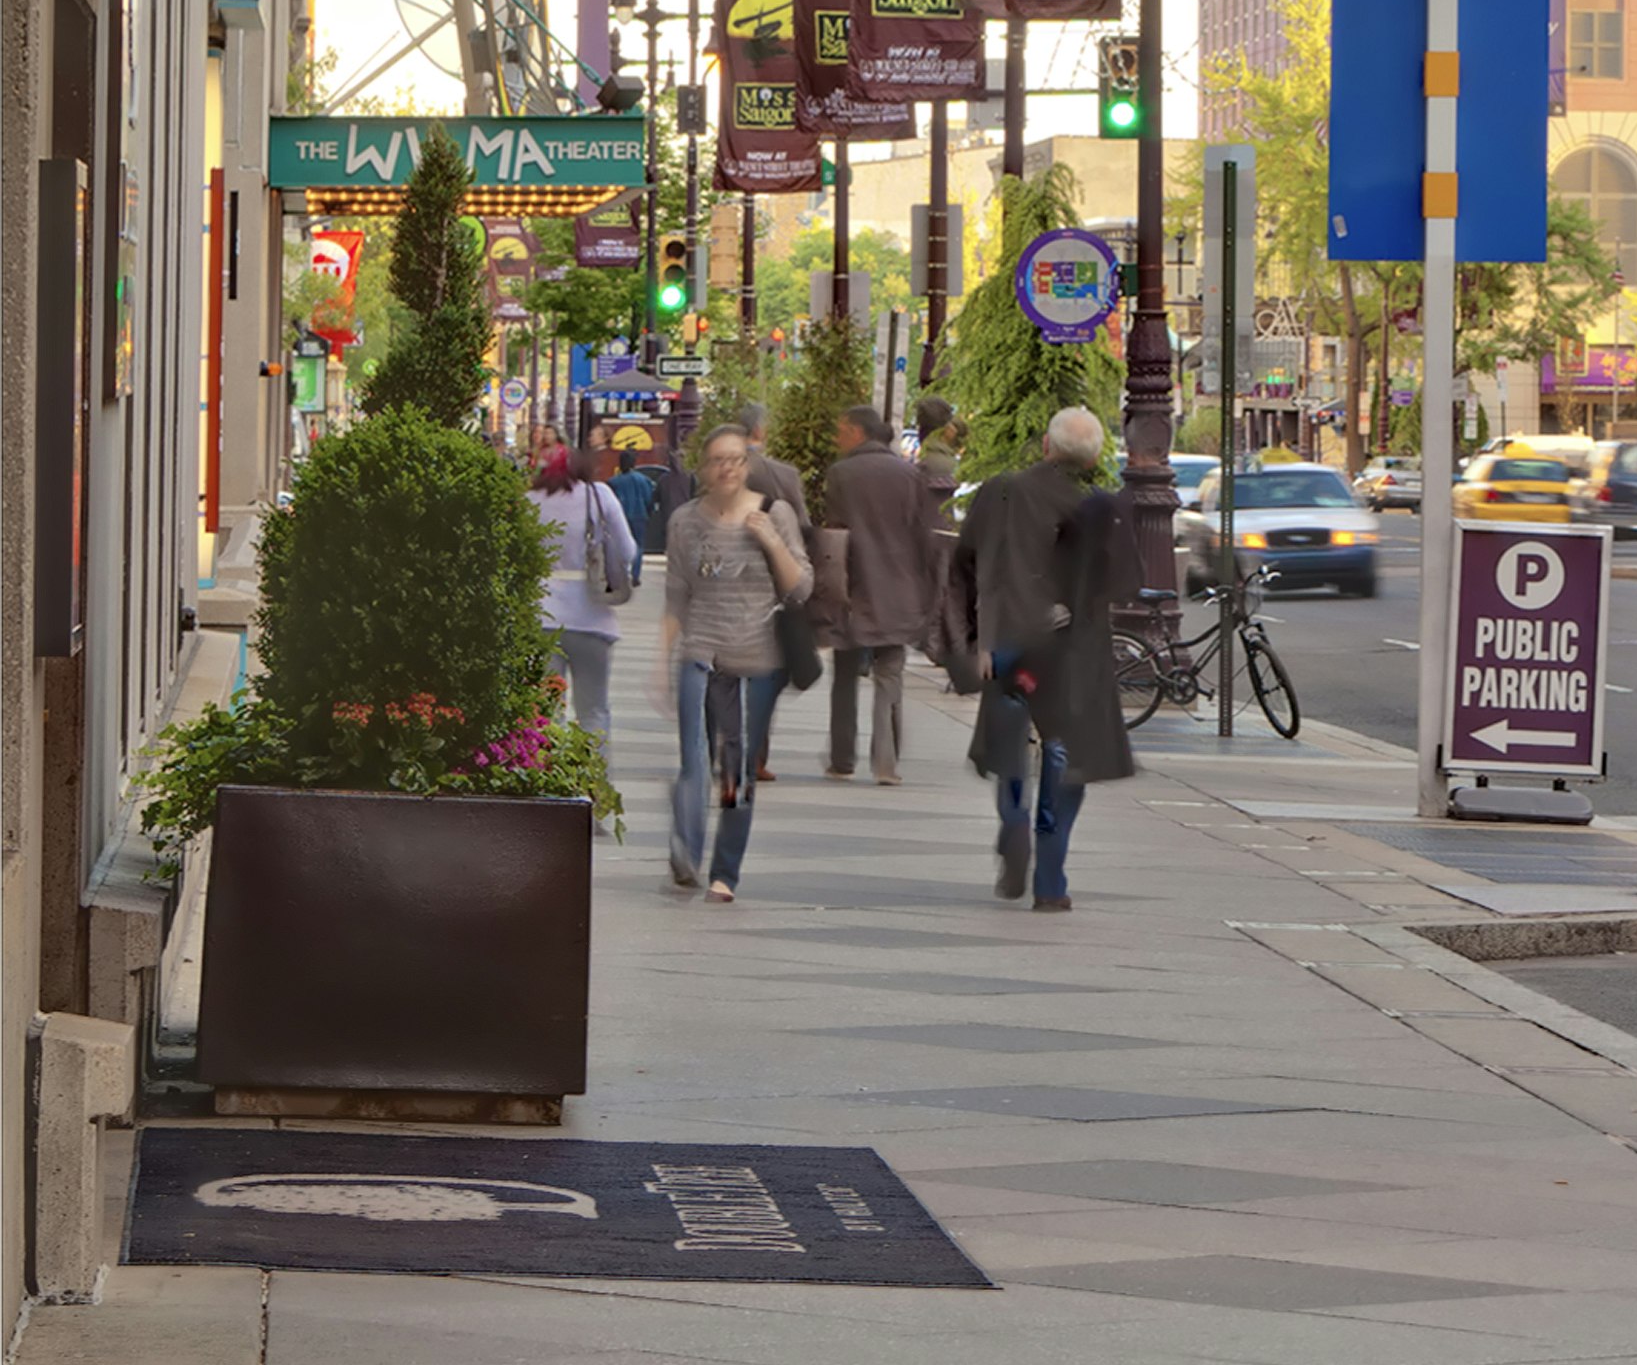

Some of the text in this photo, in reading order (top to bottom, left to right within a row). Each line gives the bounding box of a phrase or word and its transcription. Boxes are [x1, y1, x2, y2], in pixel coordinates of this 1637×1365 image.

[296, 124, 641, 182] THE WIMA THEATER
[1515, 553, 1549, 596] P
[1475, 617, 1579, 663] PUBLIC
[1462, 666, 1587, 712] PARKING
